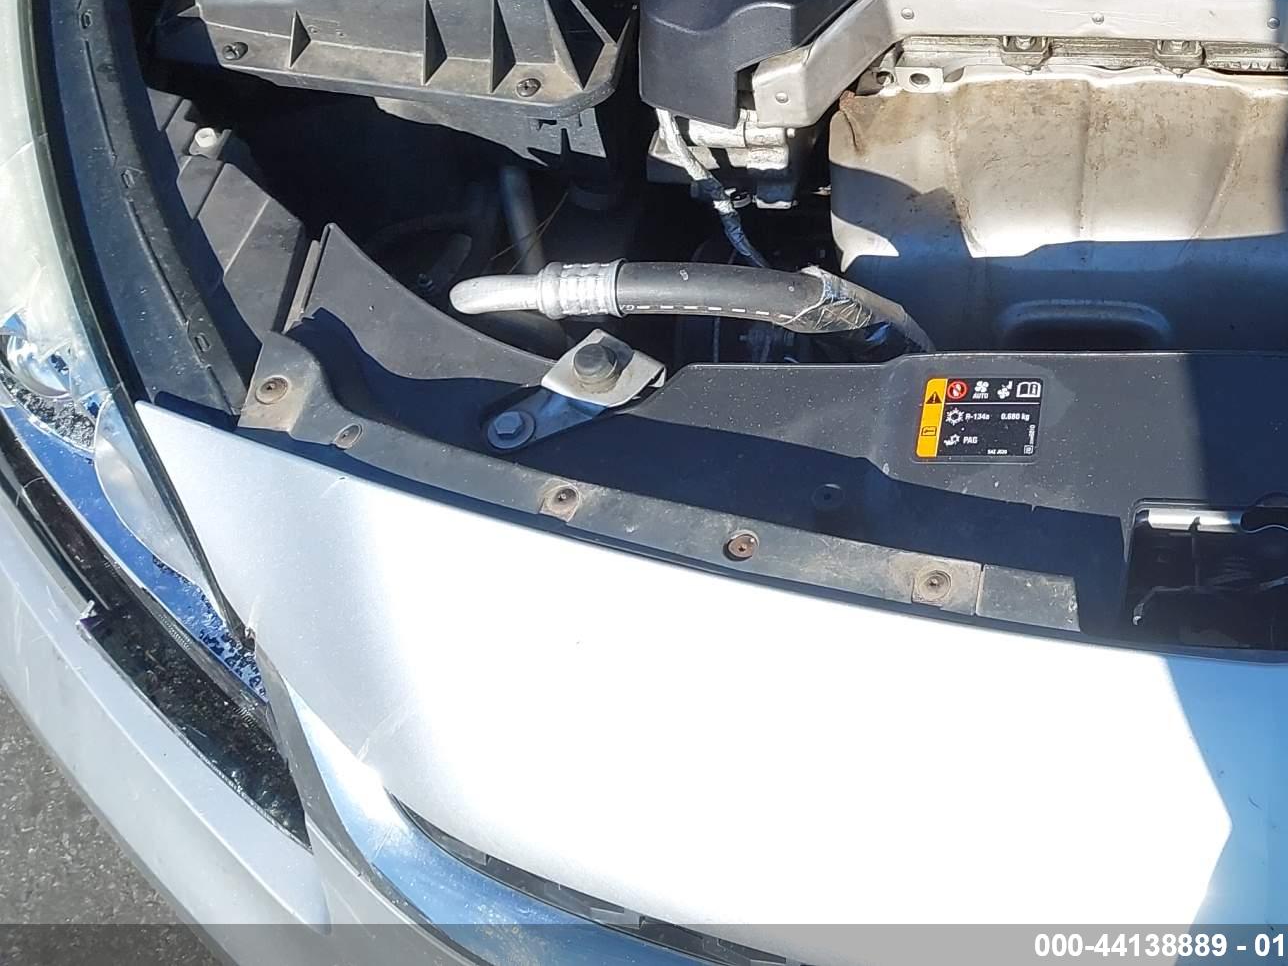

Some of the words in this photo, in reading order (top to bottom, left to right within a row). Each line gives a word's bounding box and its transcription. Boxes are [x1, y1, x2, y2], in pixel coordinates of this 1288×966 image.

[972, 392, 989, 400] AUTO
[964, 413, 990, 421] R-134a
[1021, 412, 1031, 422] kg
[962, 436, 979, 444] PAG
